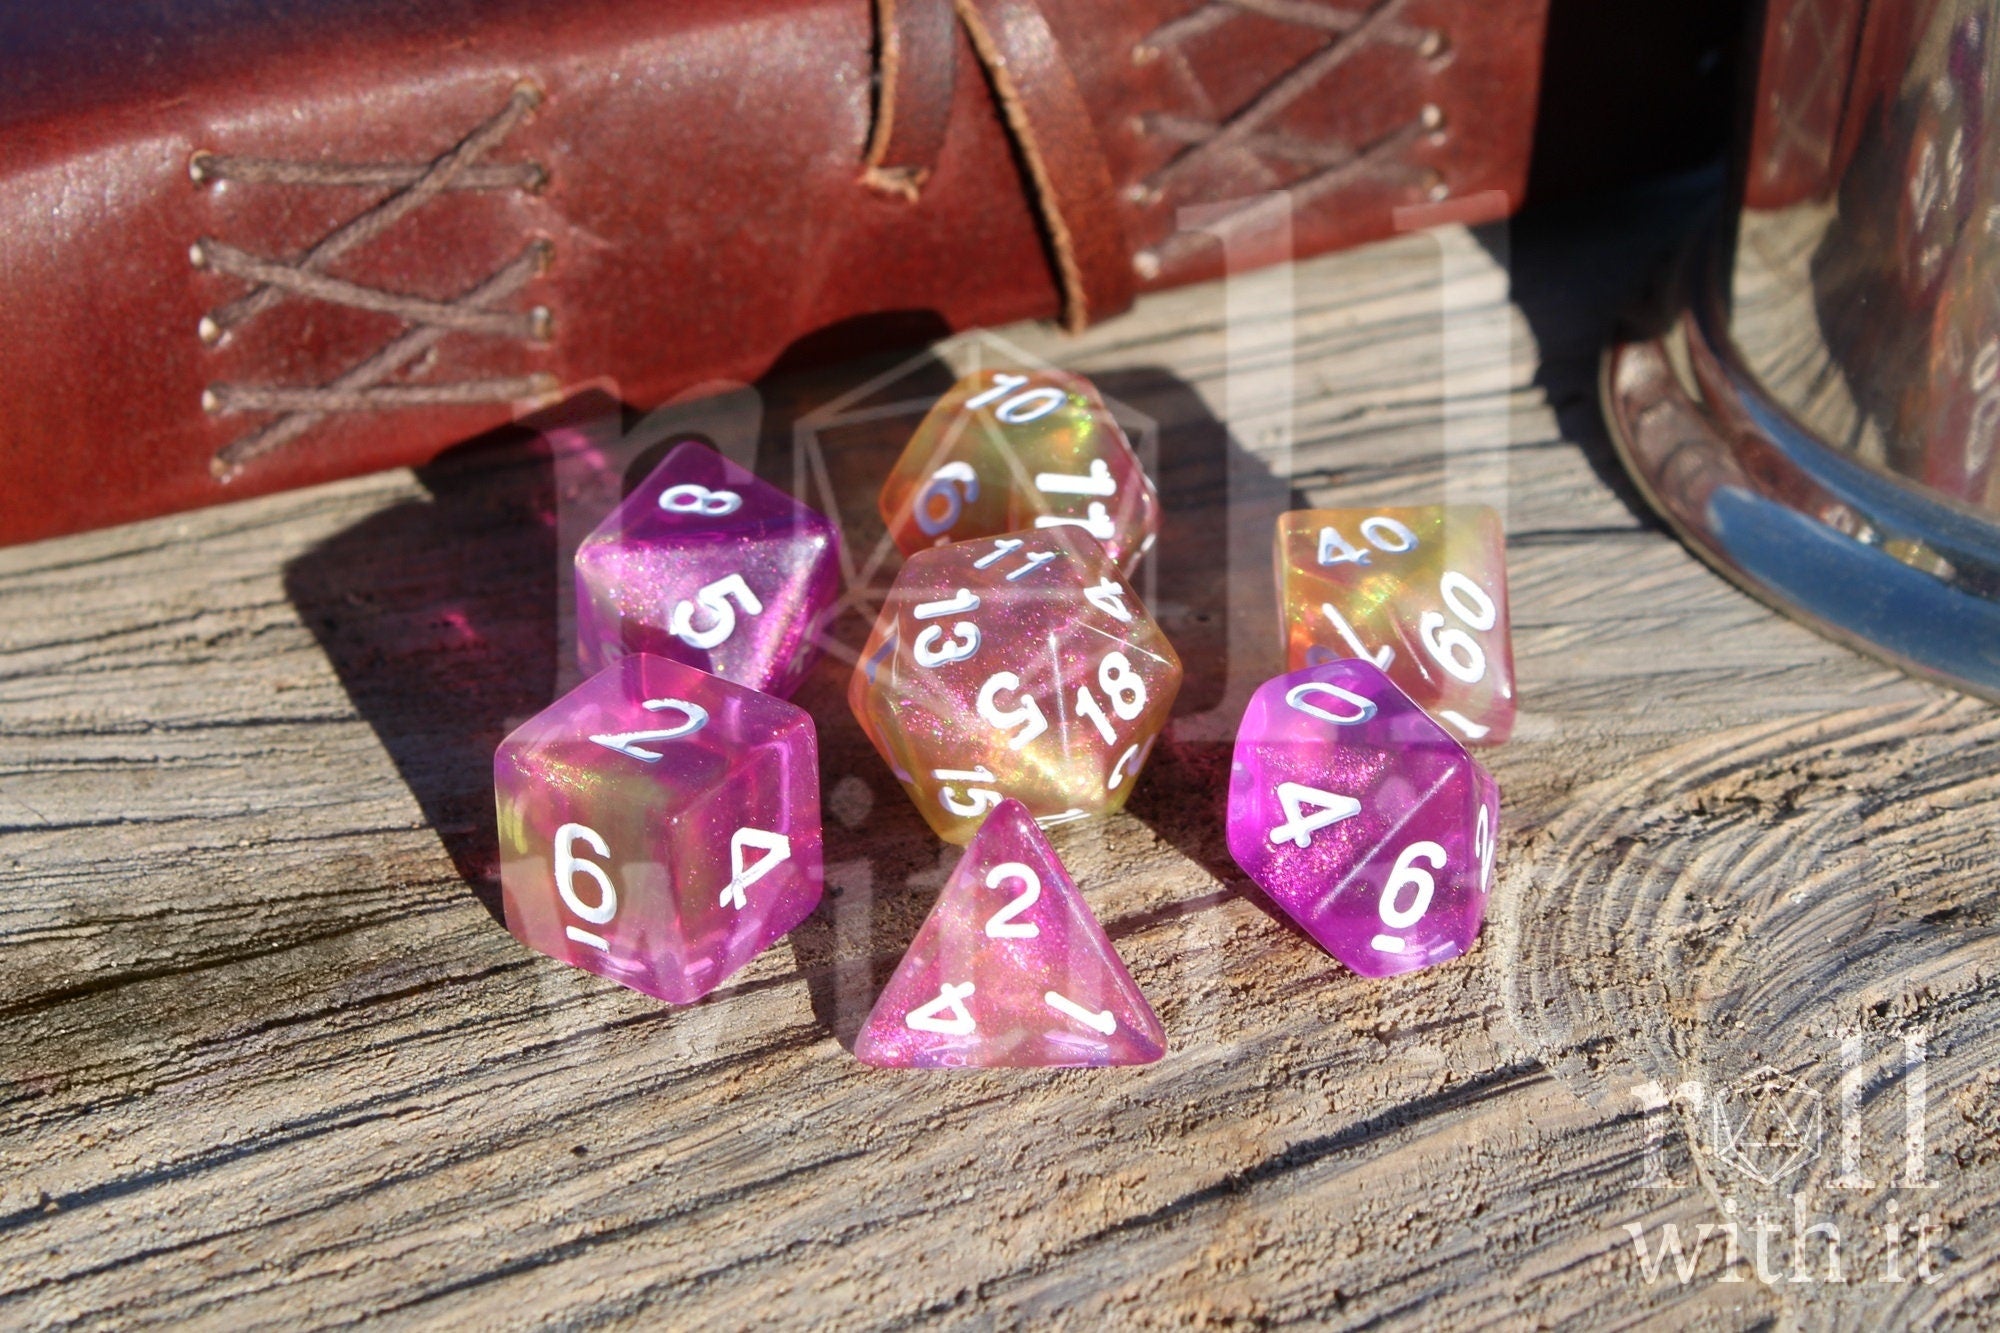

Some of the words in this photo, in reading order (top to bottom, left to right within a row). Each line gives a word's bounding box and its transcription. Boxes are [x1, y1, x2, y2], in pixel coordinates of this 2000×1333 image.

[965, 373, 1067, 424] 10
[658, 484, 742, 516] 8
[914, 461, 980, 536] 6
[973, 539, 1056, 582] 11
[1317, 516, 1420, 566] 40
[670, 573, 763, 650] 5
[913, 587, 981, 668] 13
[1419, 571, 1497, 684] 60
[588, 698, 710, 763] 2
[976, 671, 1049, 751] 5
[1075, 651, 1146, 746] 18
[1285, 681, 1378, 725] 0
[932, 765, 1004, 818] 15
[1269, 782, 1362, 849] 4
[554, 823, 618, 925] 6
[719, 827, 792, 911] 4
[984, 862, 1042, 939] 2
[1378, 840, 1448, 929] 6
[905, 981, 976, 1036] 4
[1044, 990, 1117, 1036] 1
